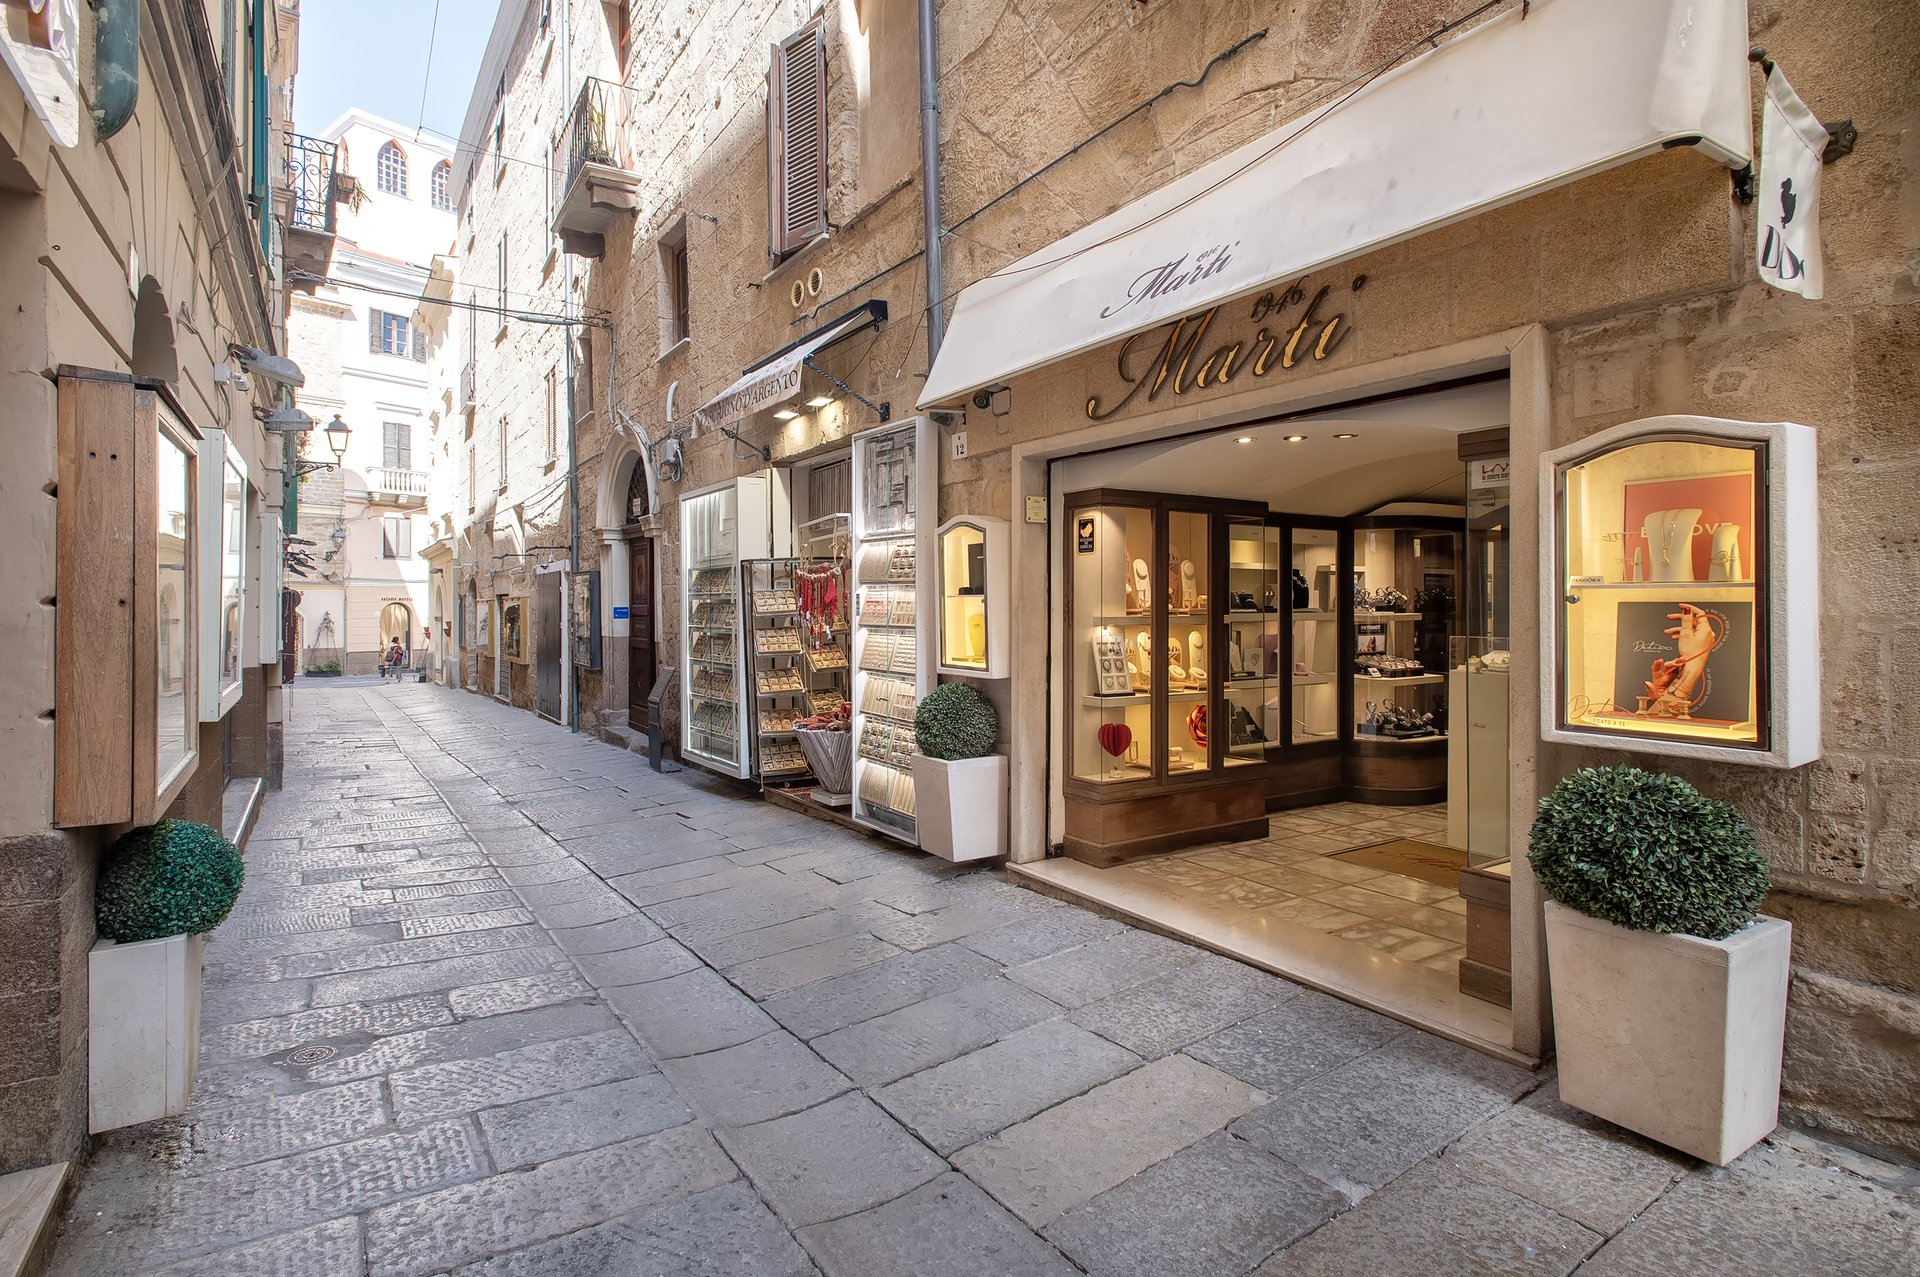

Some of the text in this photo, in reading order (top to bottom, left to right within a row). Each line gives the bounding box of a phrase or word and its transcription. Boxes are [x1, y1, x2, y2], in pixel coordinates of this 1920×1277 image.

[1250, 276, 1309, 322] 1946
[743, 369, 798, 409] D'ARGENTO
[956, 443, 964, 455] 12
